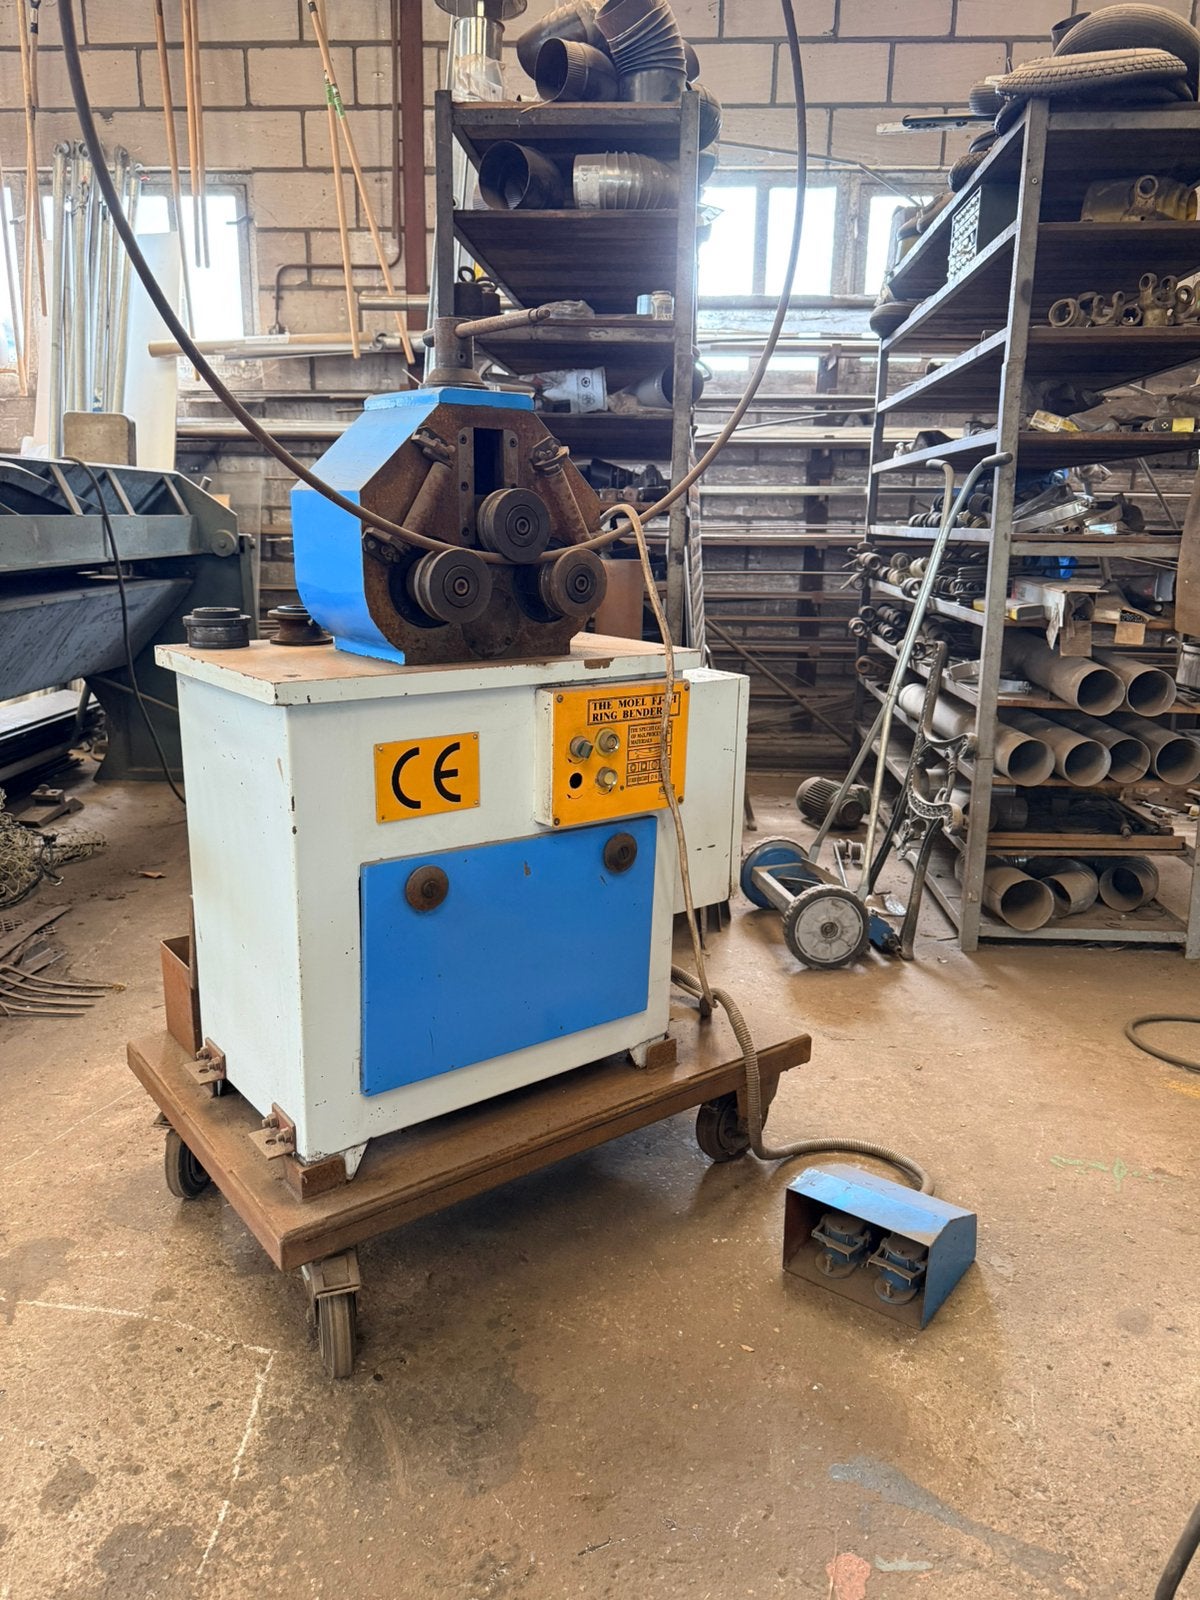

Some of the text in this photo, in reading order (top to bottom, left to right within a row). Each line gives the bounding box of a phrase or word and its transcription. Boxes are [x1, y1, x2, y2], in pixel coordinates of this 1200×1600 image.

[593, 701, 612, 711] THE
[619, 698, 647, 708] MOEL
[592, 707, 663, 721] RING BENDER
[391, 741, 462, 809] CE
